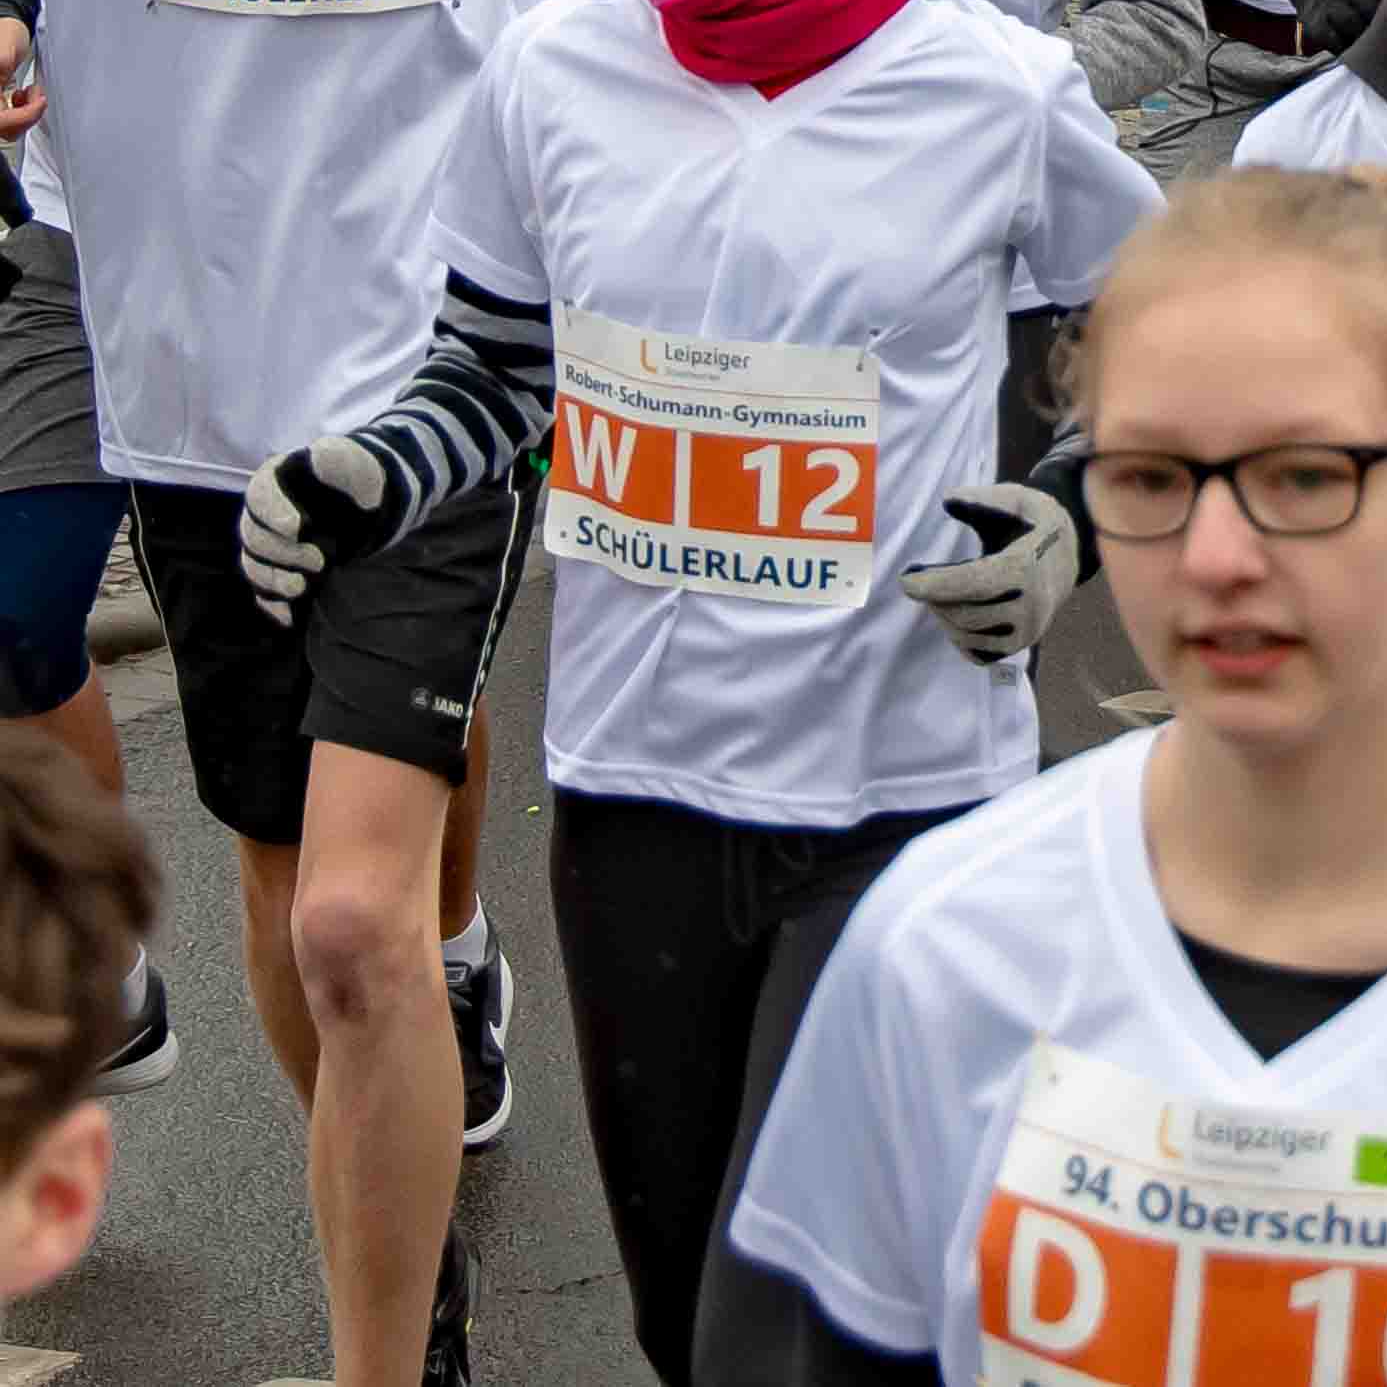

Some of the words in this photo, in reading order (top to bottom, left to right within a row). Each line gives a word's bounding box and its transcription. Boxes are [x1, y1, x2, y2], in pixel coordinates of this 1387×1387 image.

[664, 342, 751, 372] Leipziger
[565, 364, 867, 429] Robert-Schumann-Gymnasium
[565, 401, 637, 504] W
[742, 444, 861, 534] 12
[576, 515, 839, 591] SCHÜLERLAUF
[432, 695, 465, 719] JAKO
[1193, 1111, 1331, 1153] Leipziger
[1064, 1154, 1120, 1212] 94.
[1008, 1205, 1109, 1353] D
